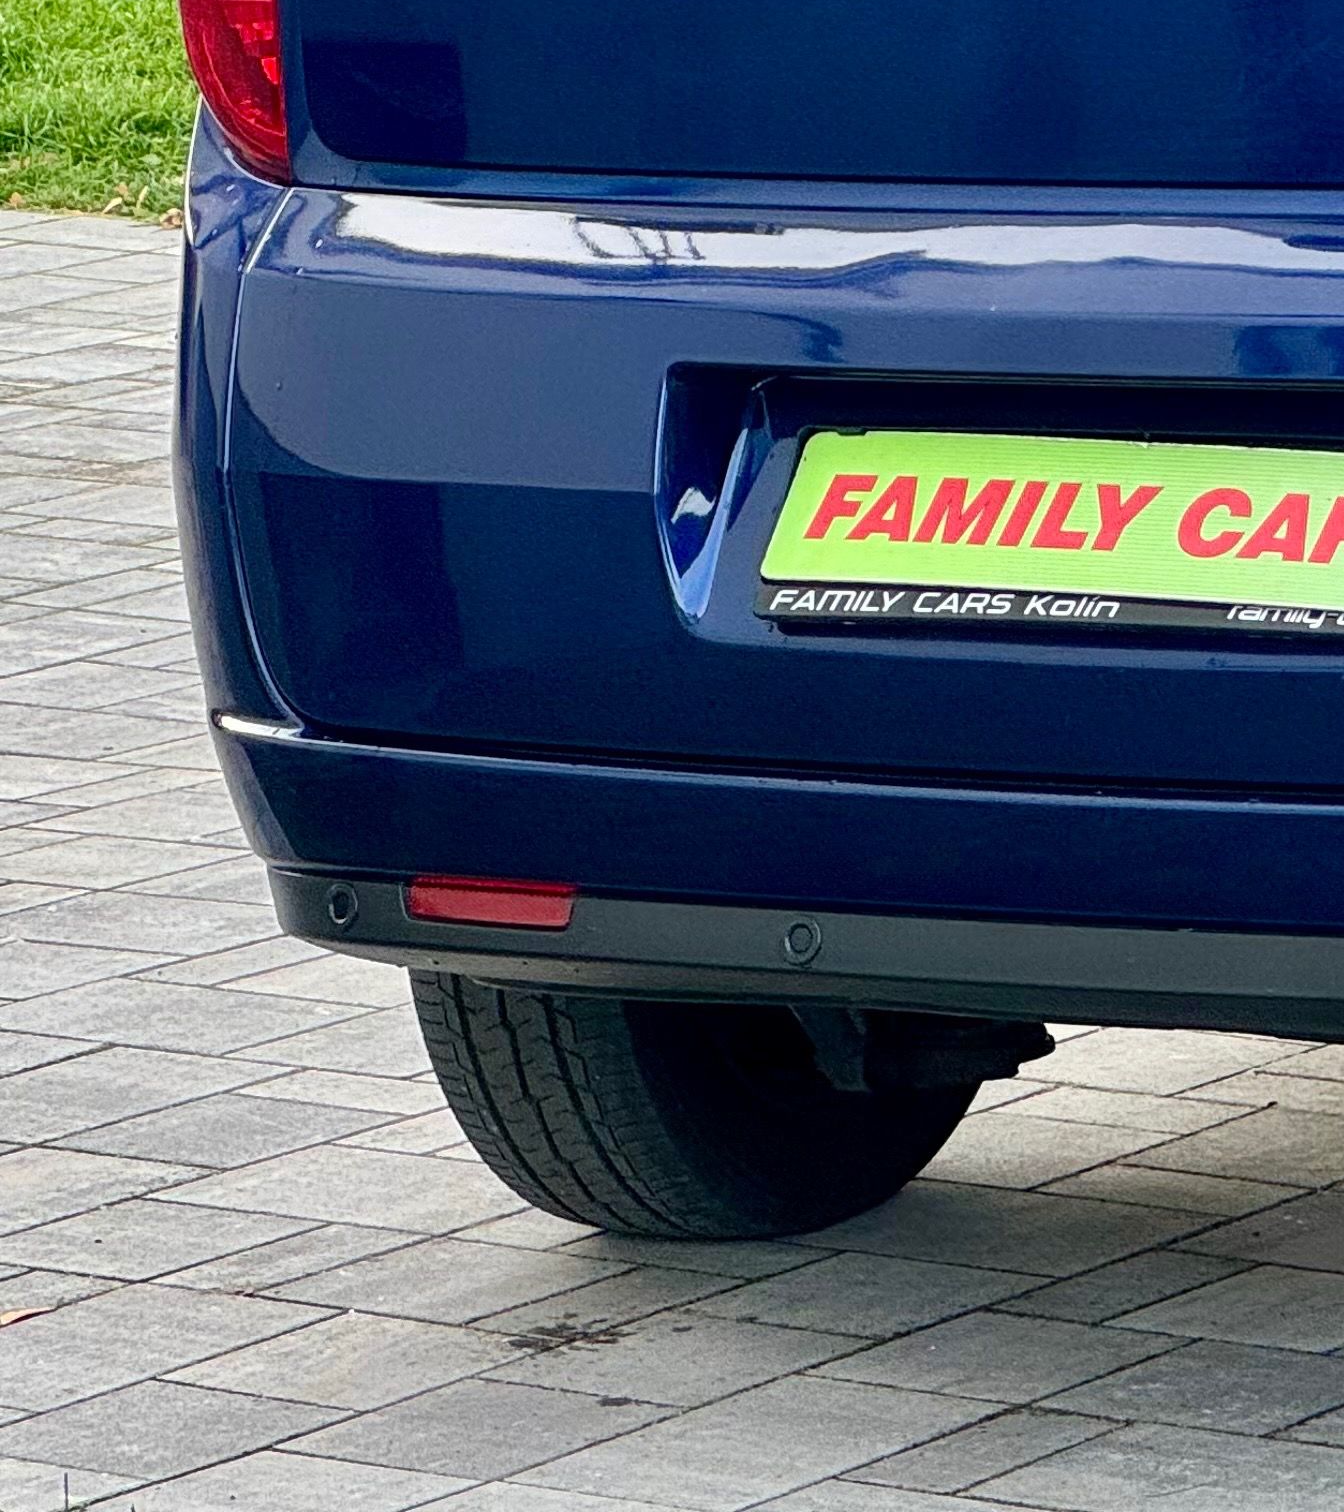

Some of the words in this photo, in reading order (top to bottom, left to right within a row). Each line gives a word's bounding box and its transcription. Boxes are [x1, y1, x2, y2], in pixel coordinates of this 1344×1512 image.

[802, 473, 1164, 552] FAMILY
[769, 589, 906, 613] FAMILY
[912, 593, 1017, 616] CARS
